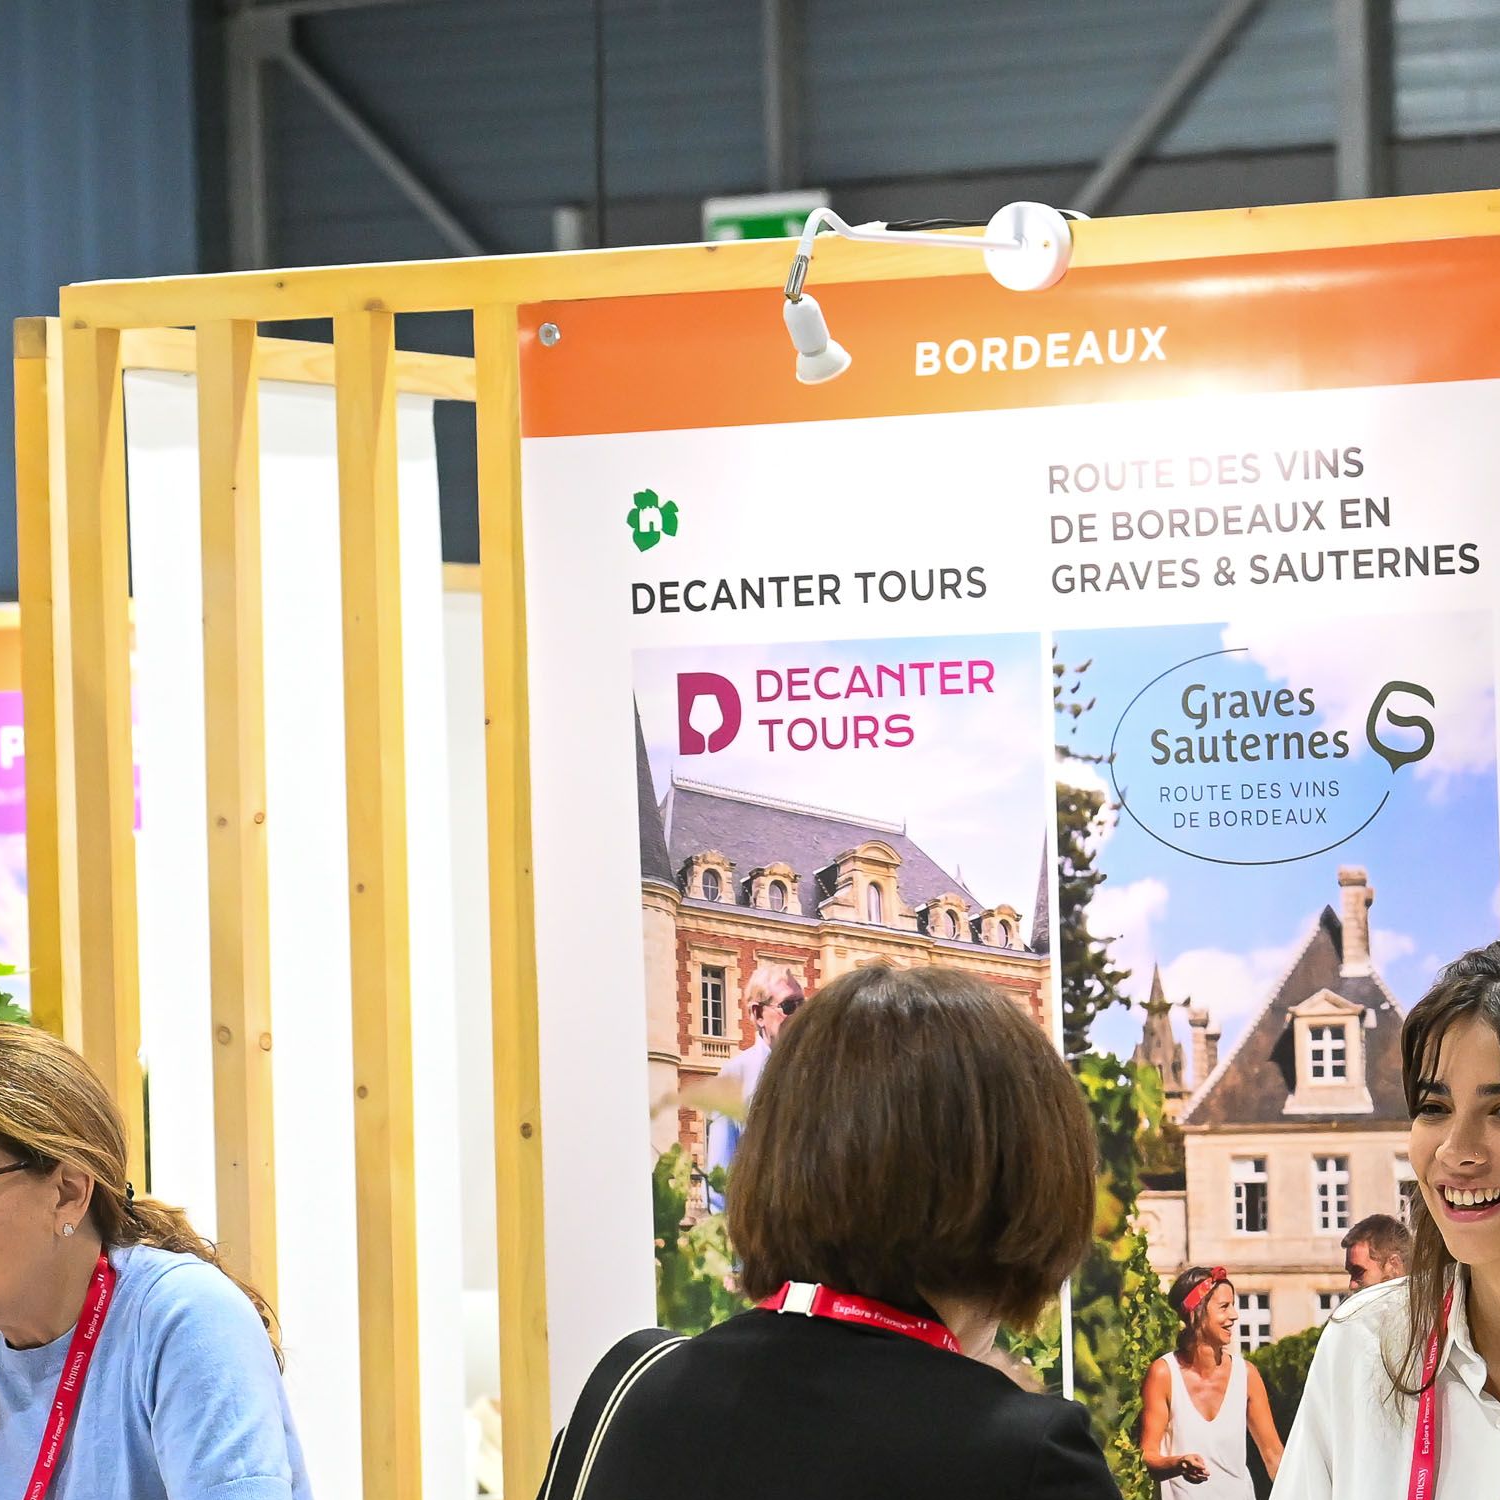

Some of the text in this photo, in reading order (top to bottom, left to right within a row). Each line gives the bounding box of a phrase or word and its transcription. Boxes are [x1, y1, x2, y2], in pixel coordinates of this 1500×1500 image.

[915, 325, 1168, 376] BORDEAUX
[1048, 446, 1365, 495] ROUTE DES VINS
[1050, 496, 1391, 544] DE BORDEAUX EN
[1051, 542, 1481, 594] GRAVES & SAUTERNES
[631, 566, 987, 615] DECANTER TOURS
[756, 659, 995, 703] DECANTER
[1181, 683, 1316, 730] Graves
[758, 714, 915, 752] TOURS
[1150, 728, 1350, 766] Sauternes
[1160, 780, 1340, 803] ROUTE DES VINS
[1173, 807, 1328, 829] DE BORDEAUX
[84, 1313, 100, 1340] Explore
[833, 1301, 871, 1319] Explore
[63, 1351, 86, 1391] Hennessy
[44, 1441, 57, 1468] Explore
[1421, 1424, 1430, 1454] Explore
